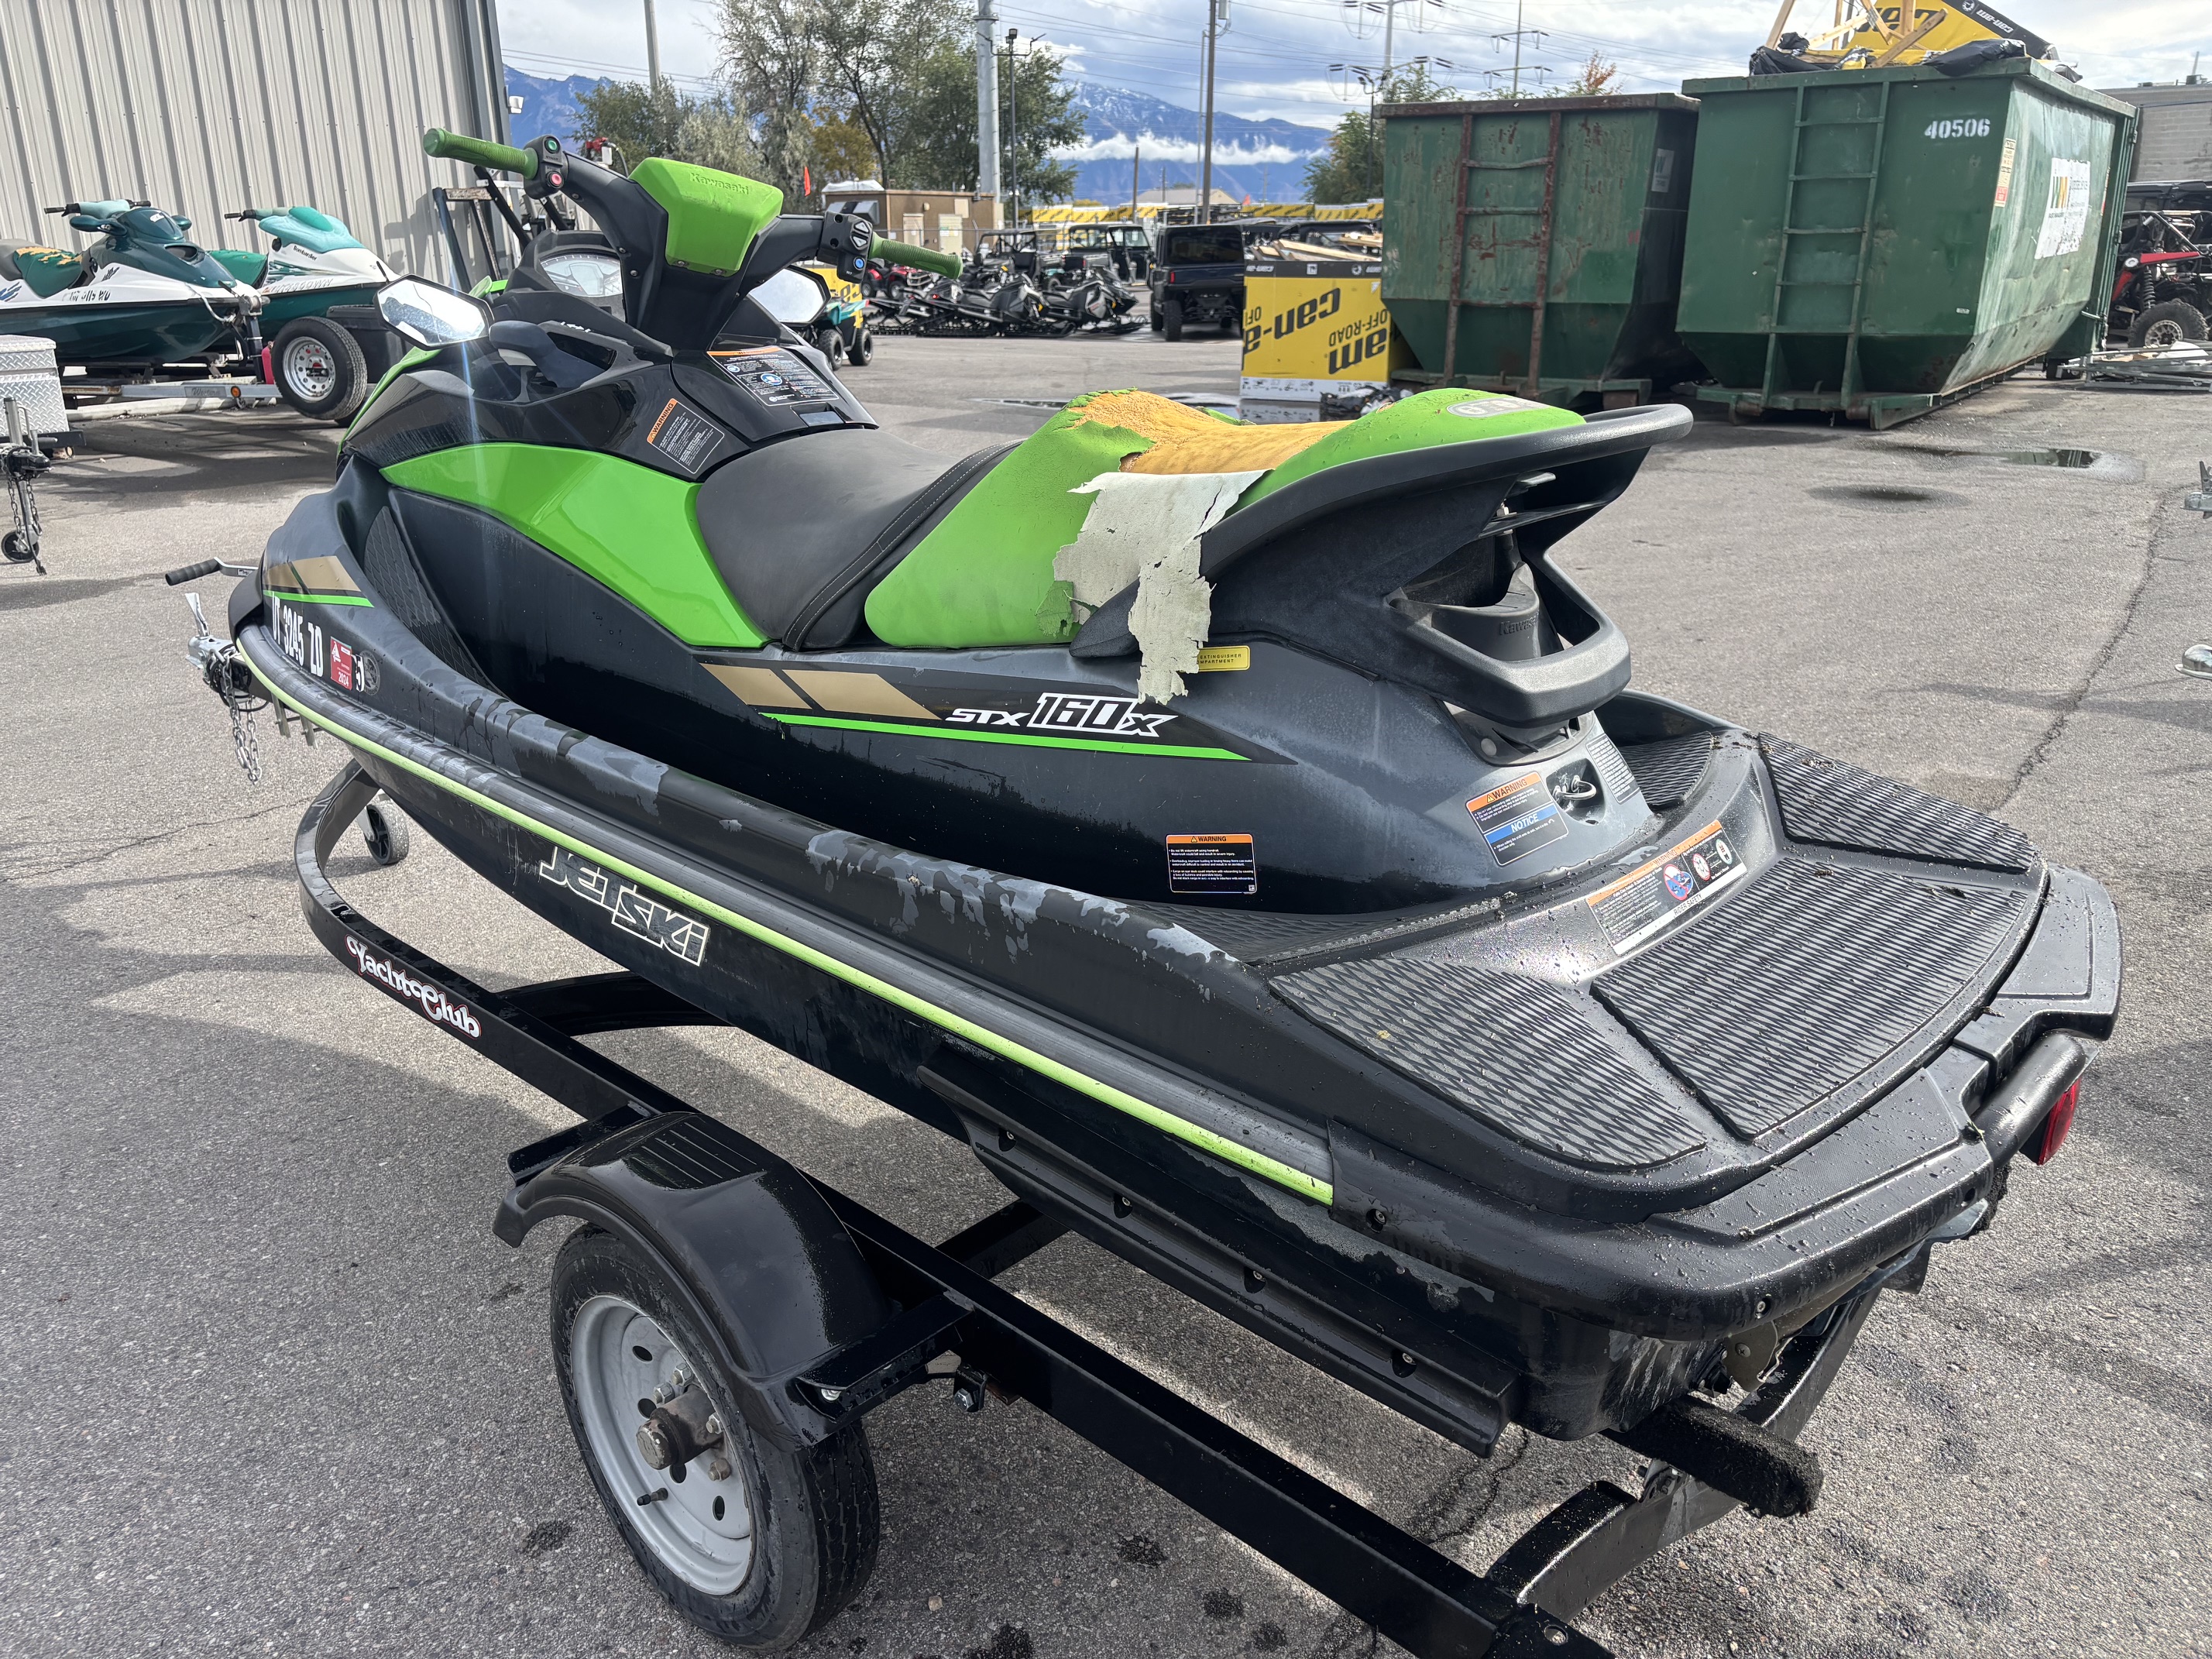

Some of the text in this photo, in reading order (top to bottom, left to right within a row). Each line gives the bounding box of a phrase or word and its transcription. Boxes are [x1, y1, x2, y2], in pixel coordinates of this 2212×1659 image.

[1976, 9, 2014, 33] can-am
[1924, 118, 1991, 139] 40506
[689, 172, 749, 195] Kawasaki
[1328, 308, 1388, 347] OFF-ROAD
[651, 403, 675, 433] WARNING
[272, 590, 281, 645] UT
[283, 604, 304, 667] 3245
[945, 708, 1031, 726] STX
[1492, 778, 1528, 799] WARNING
[1510, 812, 1540, 833] NOTICE
[1673, 894, 1703, 915] RIDER SAFETY
